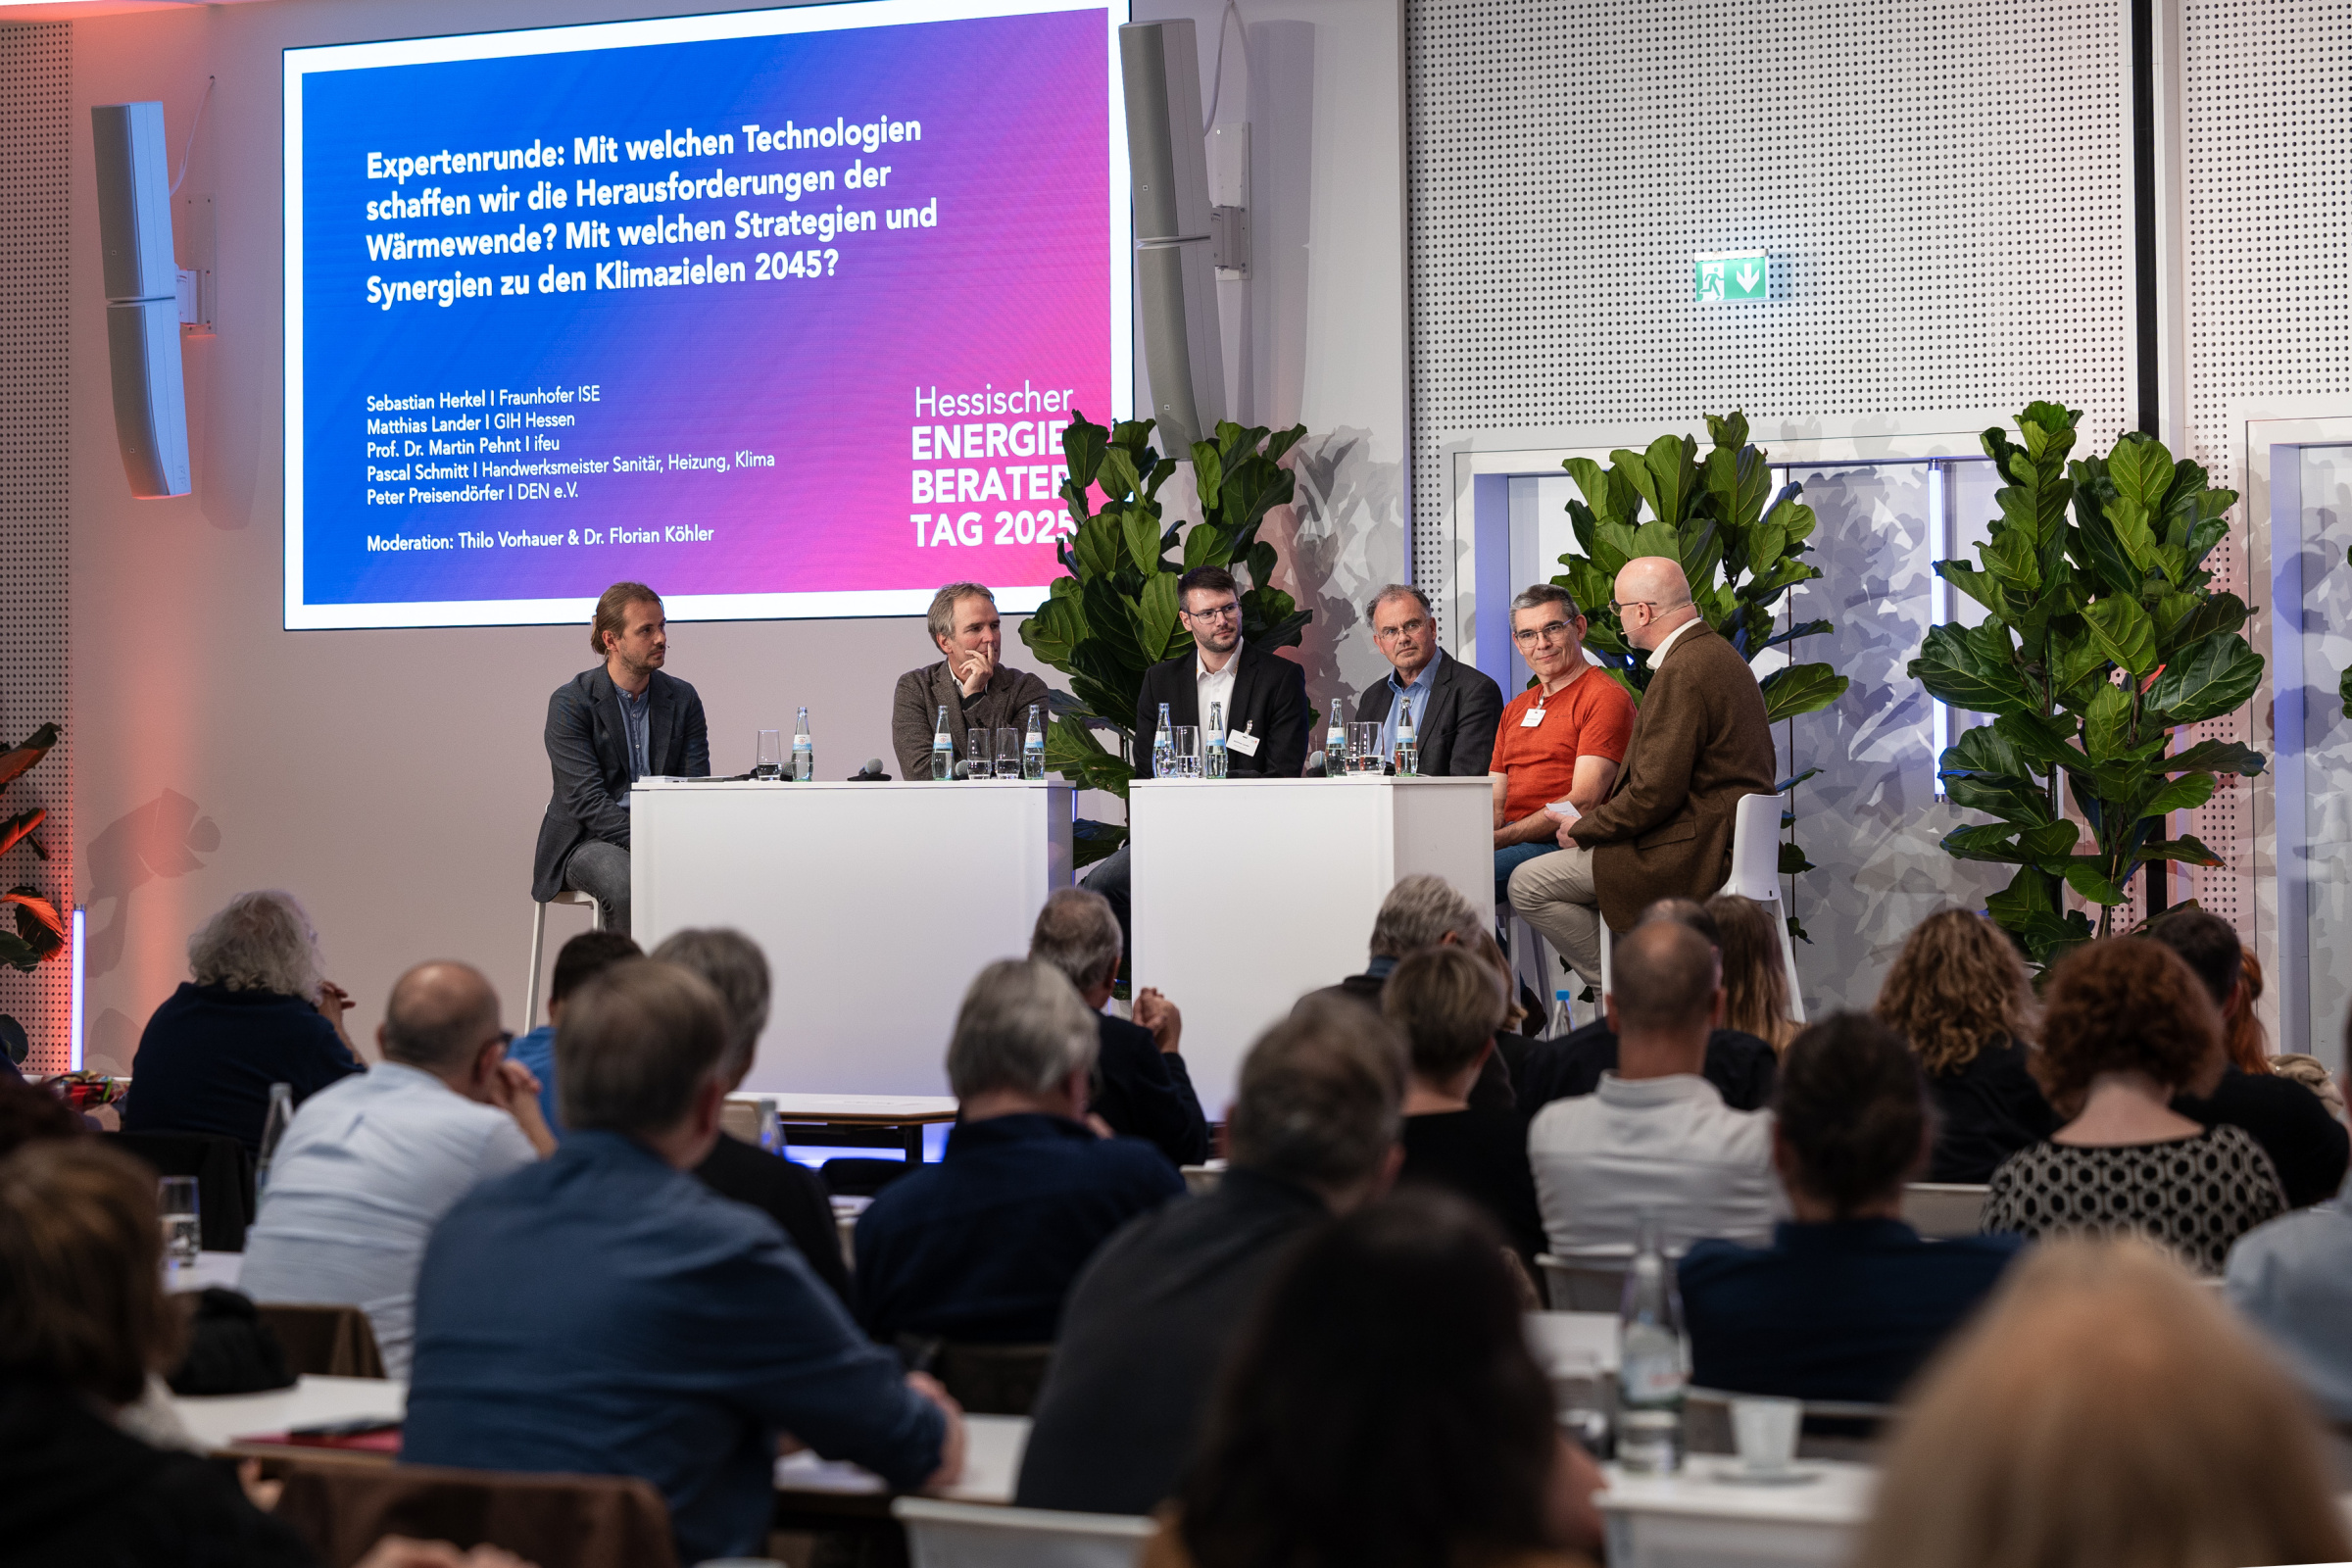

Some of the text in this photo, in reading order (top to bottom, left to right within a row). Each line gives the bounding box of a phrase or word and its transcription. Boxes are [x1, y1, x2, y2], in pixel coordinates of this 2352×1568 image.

[367, 114, 920, 184] Expertenrunde: Mit welchen Technologien
[366, 158, 891, 220] schaffen wir die Herausforderungen der
[366, 196, 937, 261] Wärmewende? Mit welchen Strategien und
[367, 248, 839, 311] Synergien zu den Klimazielen 2045?
[367, 393, 434, 412] Sebastian
[439, 389, 485, 408] Herkel
[499, 385, 574, 406] Fraunhofer
[578, 384, 600, 402] ISE
[915, 379, 1073, 417] Hessischer
[367, 416, 427, 434] Matthias
[431, 413, 481, 432] Lander
[494, 412, 520, 429] GIH
[525, 411, 574, 427] Hessen
[911, 419, 1068, 460] ENERGIE
[367, 439, 399, 458] Prof.
[404, 440, 423, 457] Dr.
[428, 438, 474, 455] Martin
[479, 435, 520, 453] Pehnt
[534, 433, 559, 451] ifeu
[367, 463, 410, 481] Pascal
[415, 462, 468, 479] Schmitt
[482, 458, 609, 477] Handwerksmeister
[612, 455, 662, 473] Sanitär,
[668, 453, 730, 472] Heizung,
[735, 449, 774, 467] Klima
[367, 488, 405, 505] Peter
[409, 483, 505, 503] Preisendörfer
[517, 482, 549, 500] DEN
[553, 481, 578, 498] e.V.
[367, 523, 714, 551] Moderation: Thilo Vorhauer & Dr. Florian Köhler
[909, 509, 1076, 547] TAG 2025
